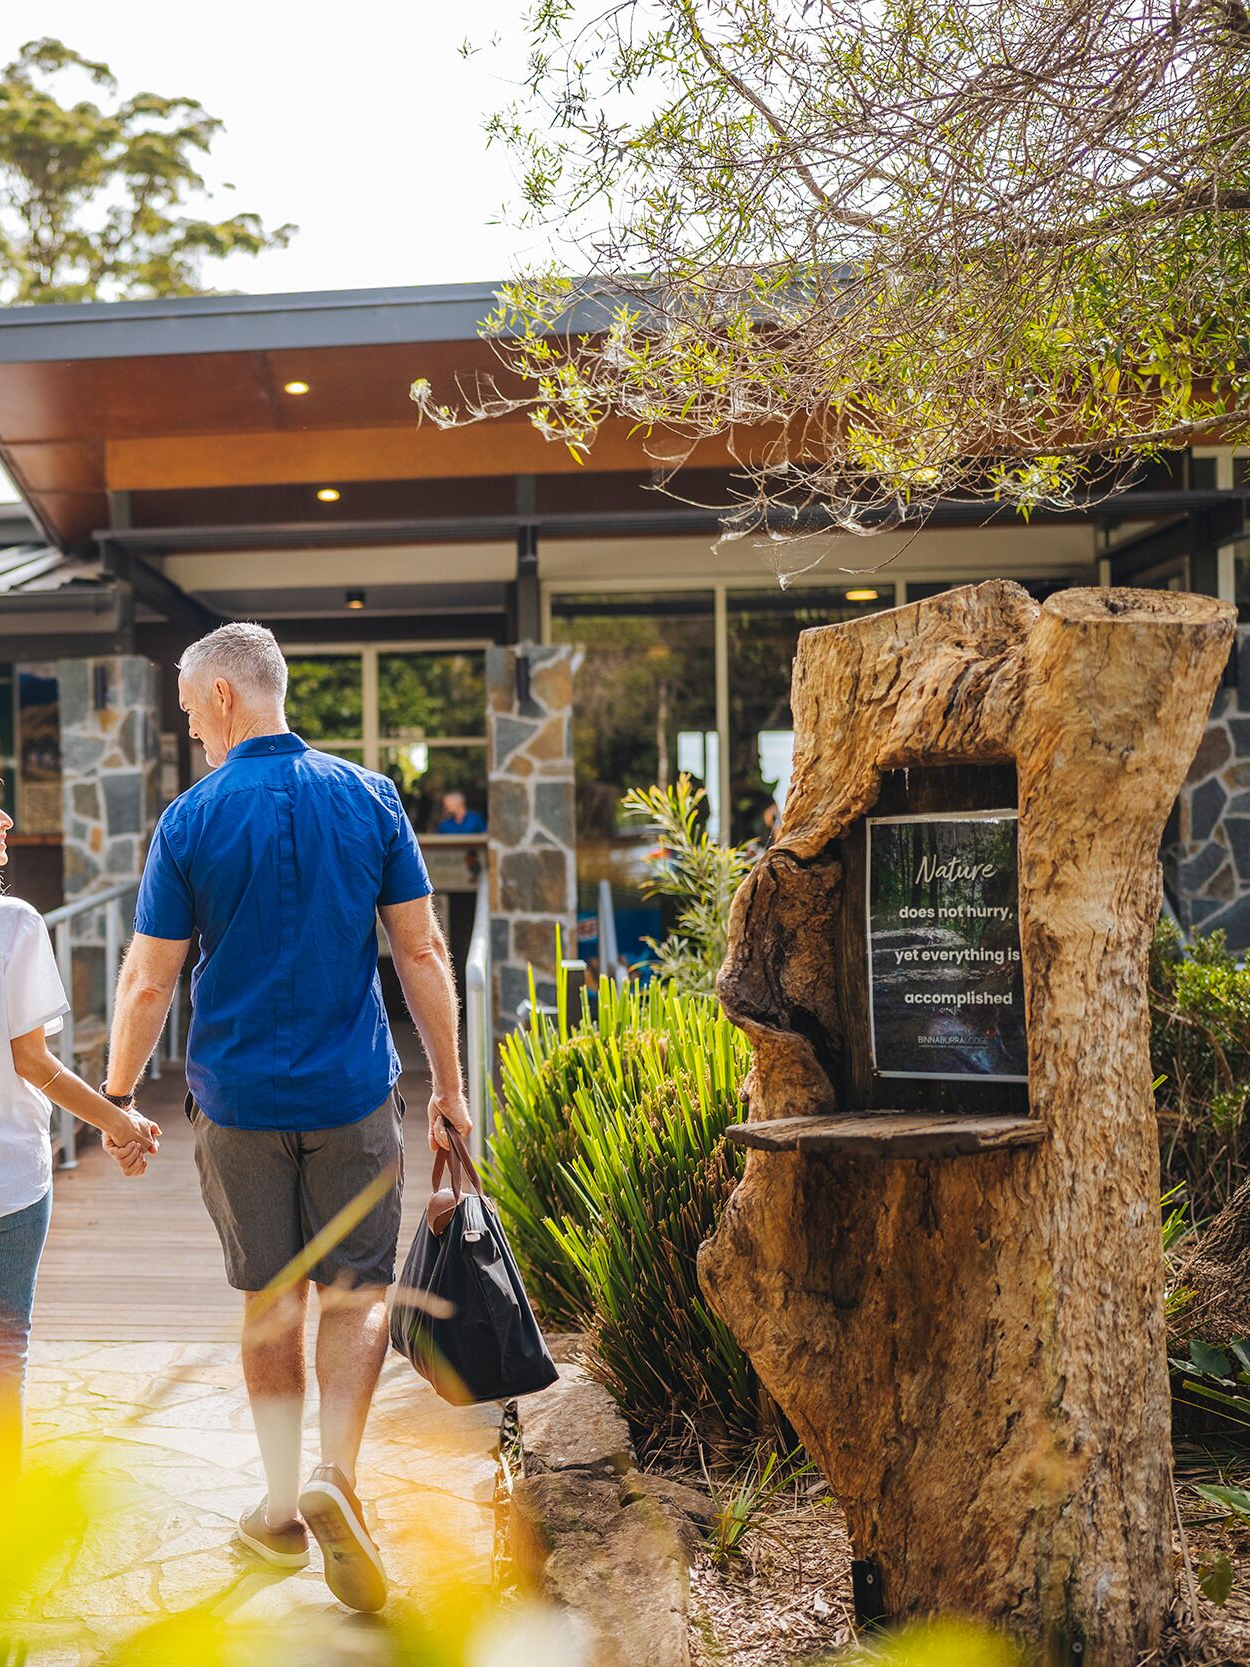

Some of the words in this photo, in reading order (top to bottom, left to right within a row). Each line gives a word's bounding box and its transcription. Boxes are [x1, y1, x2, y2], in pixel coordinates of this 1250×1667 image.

[914, 854, 998, 885] Nature
[899, 905, 935, 919] does
[938, 905, 964, 918] not
[966, 904, 1014, 920] hurry,
[894, 948, 919, 964] yet
[921, 947, 1005, 966] everything
[1007, 947, 1021, 961] is
[904, 991, 1013, 1008] accomplished
